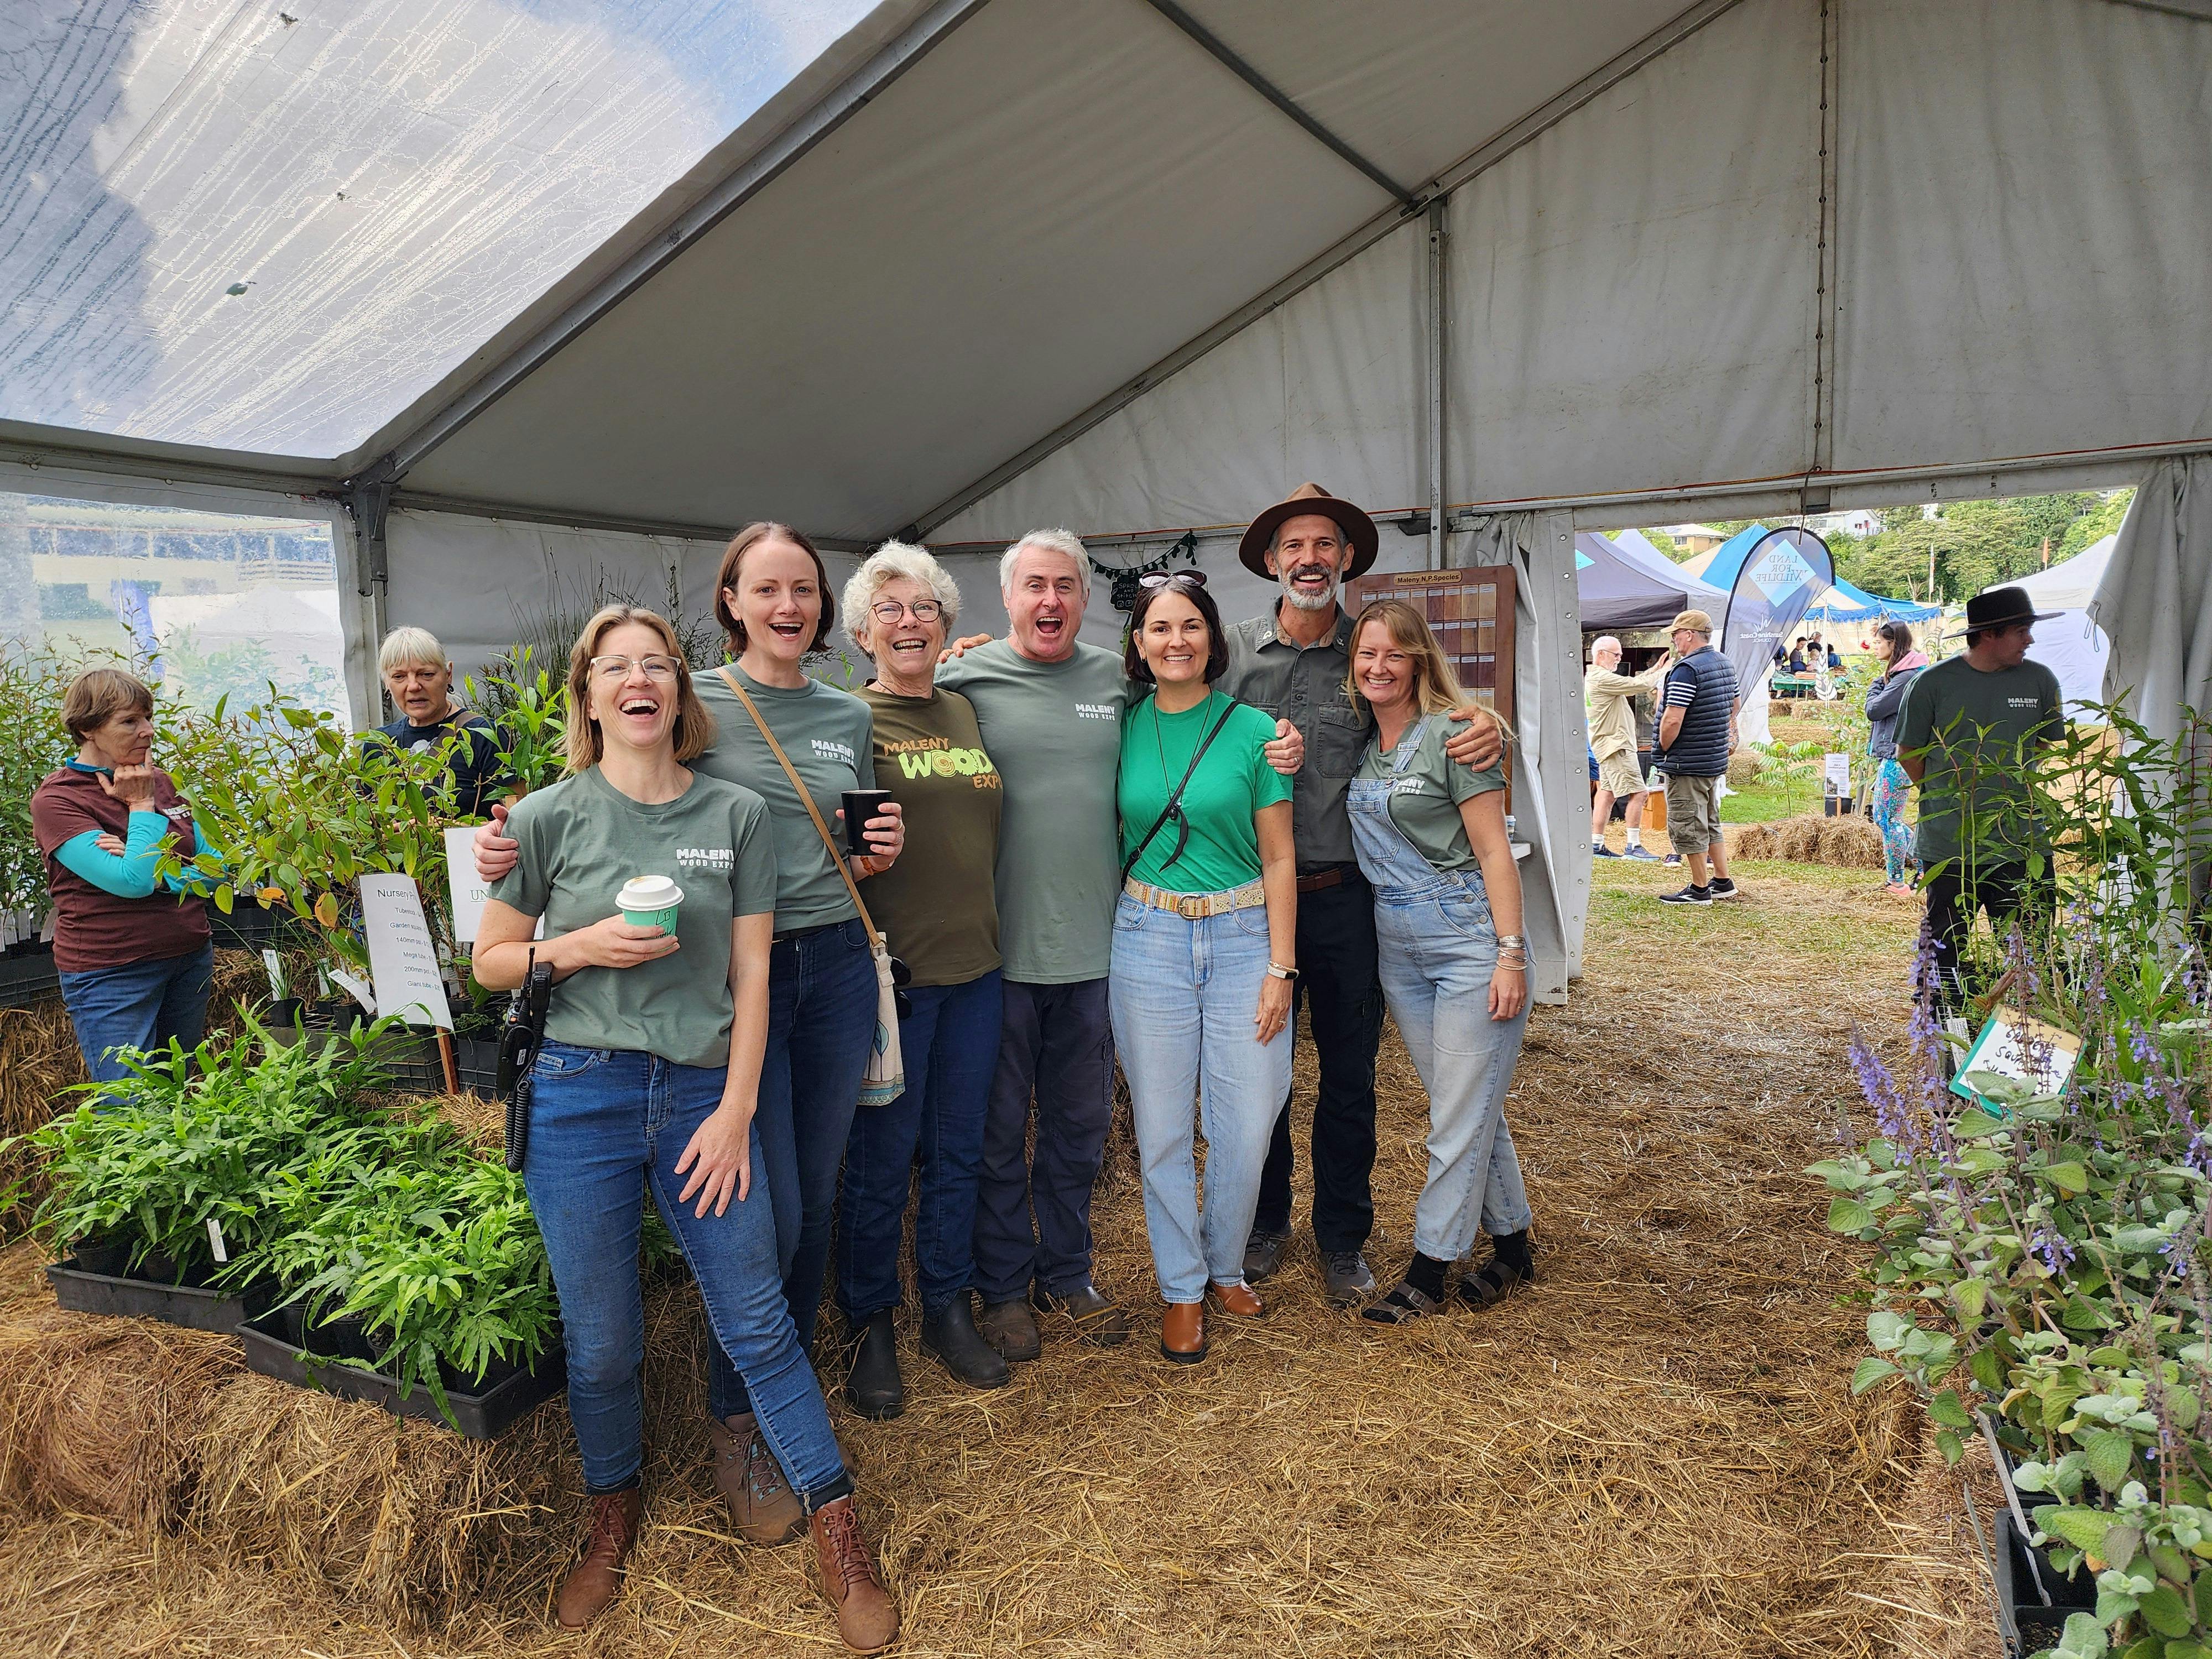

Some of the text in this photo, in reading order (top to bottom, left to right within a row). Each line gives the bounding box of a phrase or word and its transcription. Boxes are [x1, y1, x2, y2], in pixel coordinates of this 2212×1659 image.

[1075, 703, 1115, 714] MALENY
[811, 739, 854, 760] MALENY
[884, 737, 950, 757] MALENY
[814, 750, 854, 765] WOOD EXPO
[898, 747, 993, 779] WOOD
[1401, 786, 1421, 795] EXPO
[712, 860, 733, 870] EXPO
[377, 889, 409, 900] Nursery
